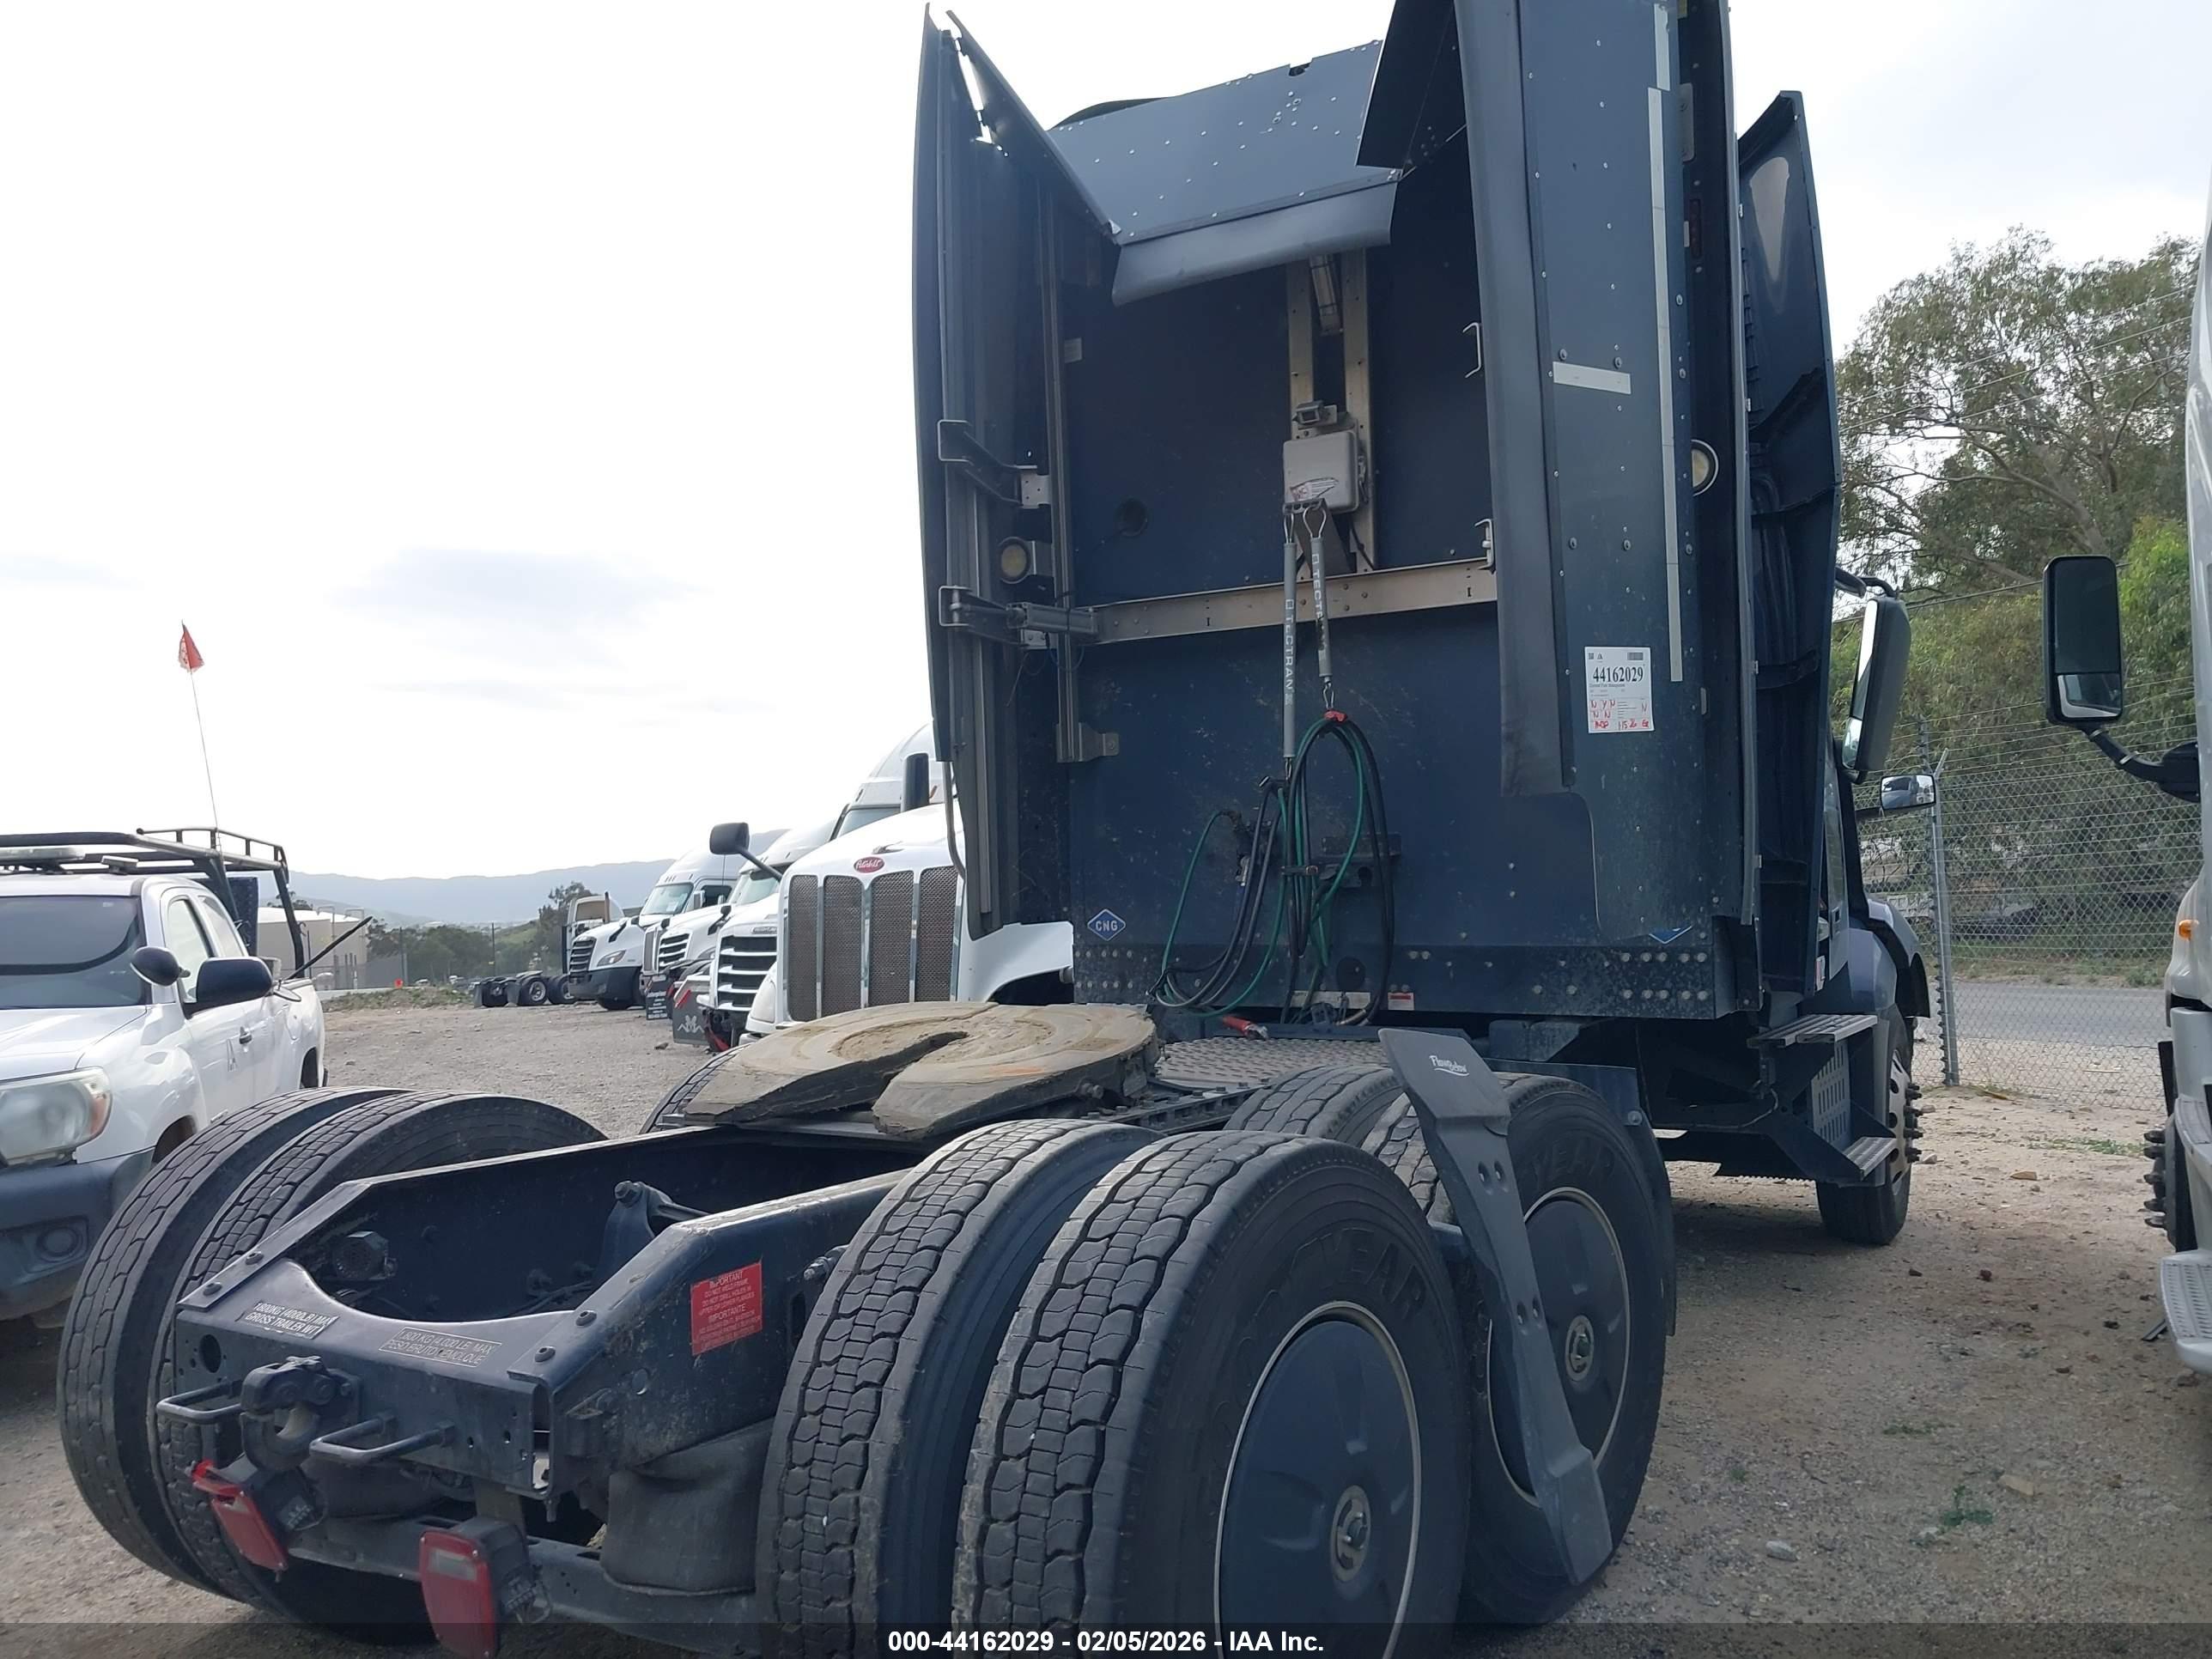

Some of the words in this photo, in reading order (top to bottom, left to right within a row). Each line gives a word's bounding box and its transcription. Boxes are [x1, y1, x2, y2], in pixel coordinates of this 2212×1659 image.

[1285, 614, 1295, 690] TECTRAN
[1593, 666, 1644, 683] 44162029
[1096, 920, 1118, 932] CNG
[245, 1311, 276, 1324] GROSS
[270, 1316, 306, 1331] TRAILER
[301, 1322, 320, 1334] WT
